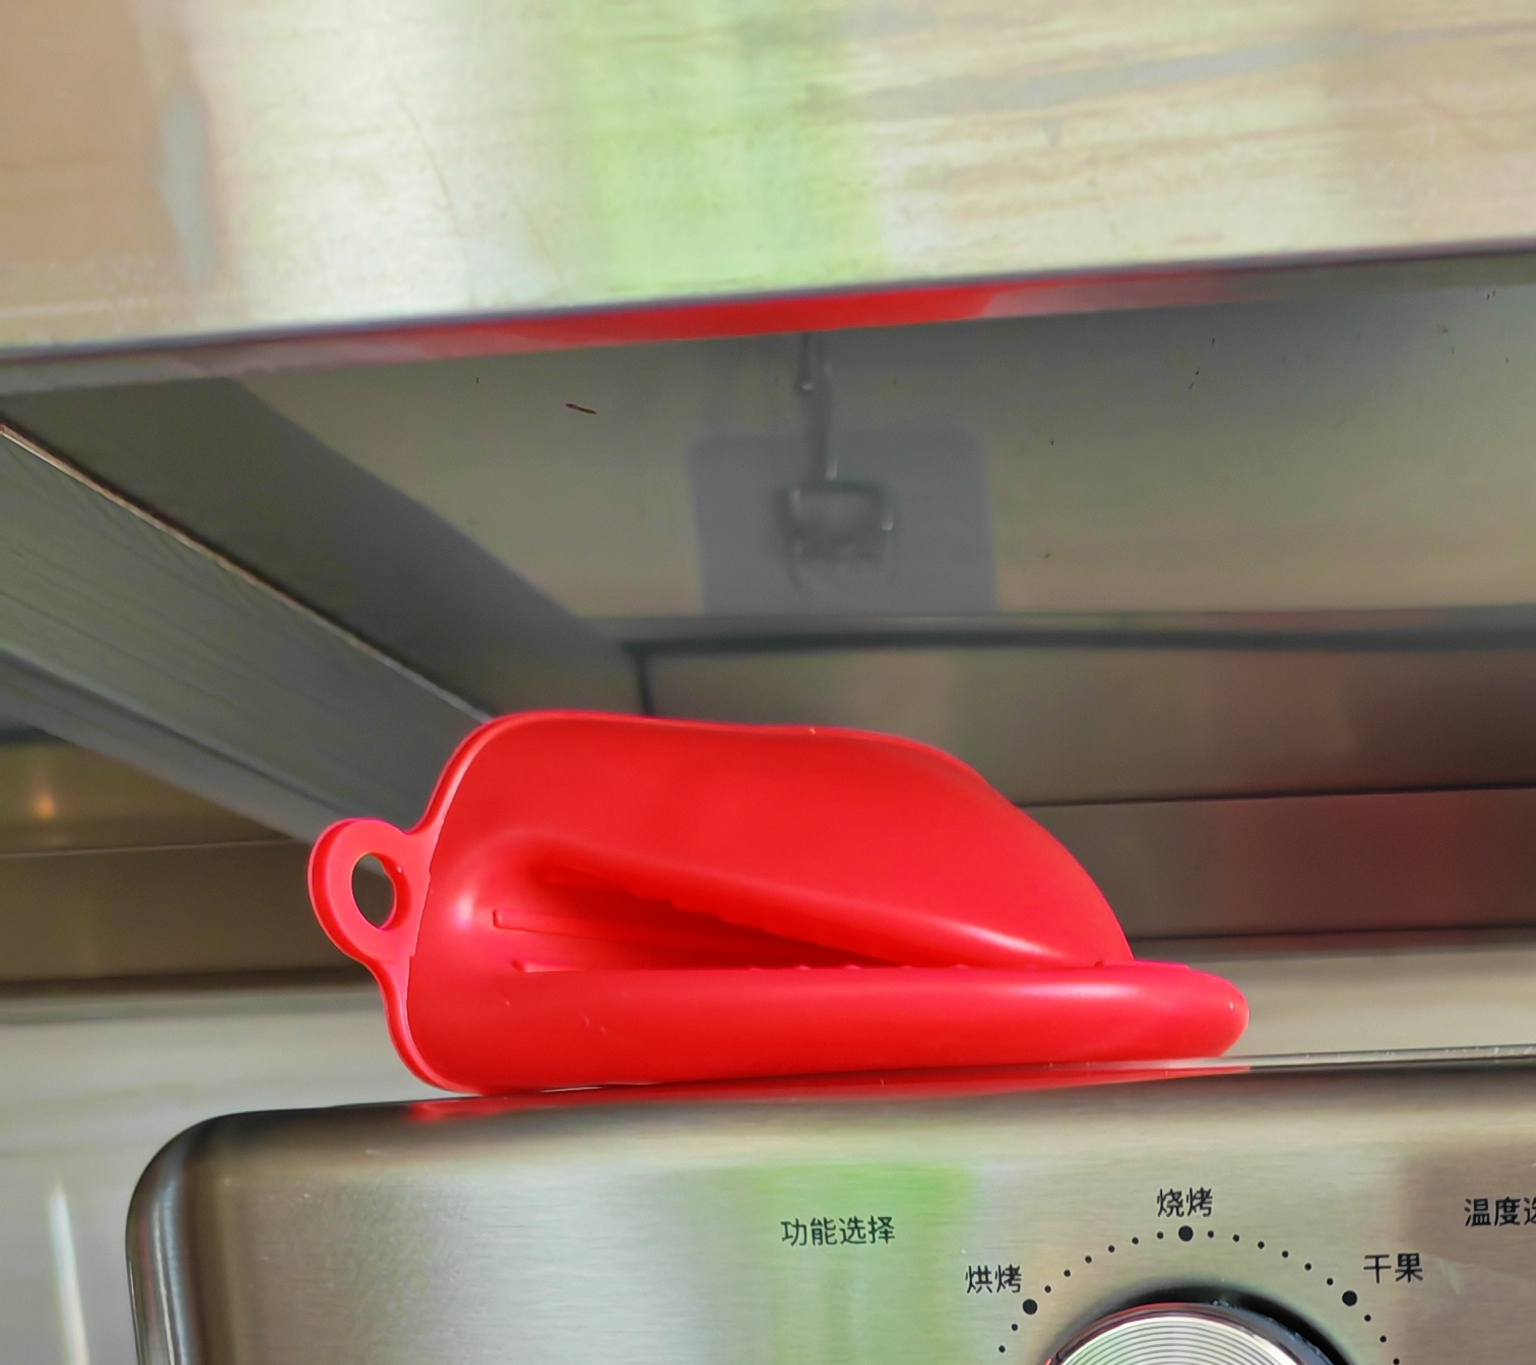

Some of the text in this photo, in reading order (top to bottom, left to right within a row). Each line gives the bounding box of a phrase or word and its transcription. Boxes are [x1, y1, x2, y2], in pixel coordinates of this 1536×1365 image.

[1156, 1188, 1214, 1219] 烧烤
[781, 1216, 896, 1247] 功能选择
[965, 1264, 1024, 1296] 烘烤
[1364, 1253, 1423, 1283] 干果
